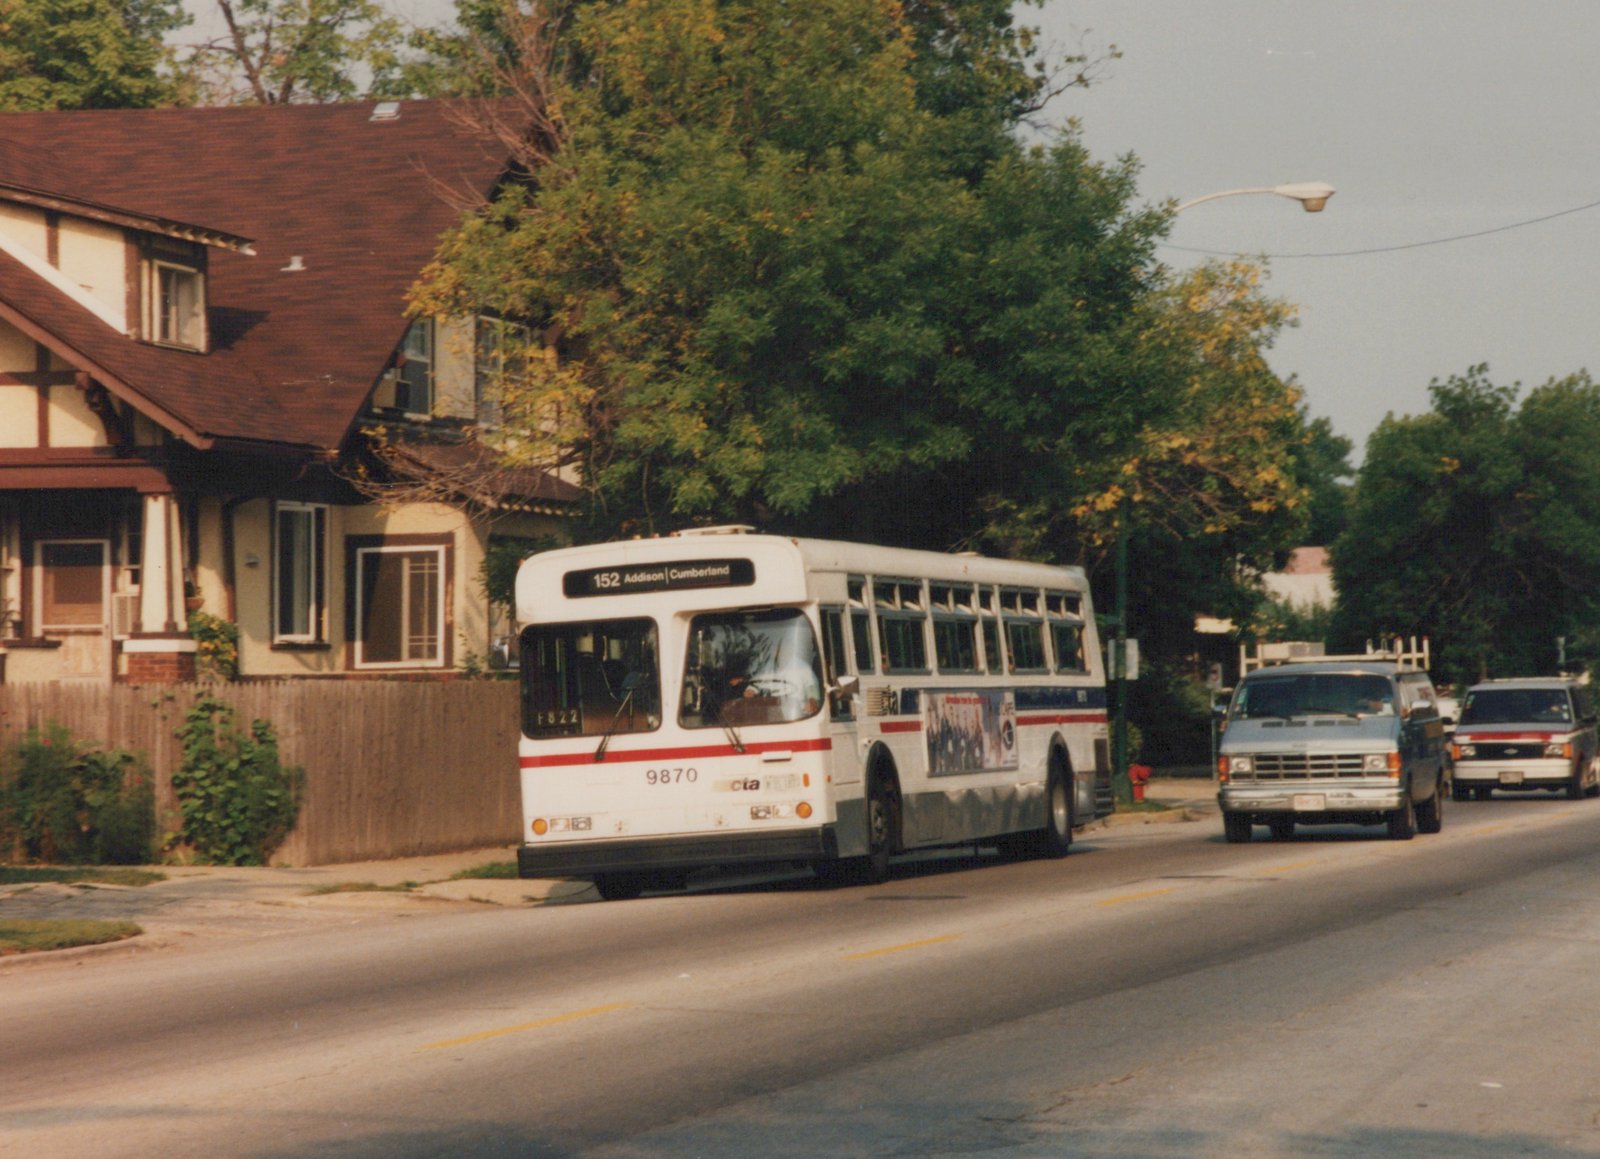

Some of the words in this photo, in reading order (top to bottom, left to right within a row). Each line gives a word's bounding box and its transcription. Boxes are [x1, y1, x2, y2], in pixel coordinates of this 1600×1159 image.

[594, 572, 620, 588] 152
[624, 569, 664, 583] Addison
[669, 565, 730, 580] Cumberland
[646, 768, 698, 785] 9870
[730, 777, 761, 792] cta
